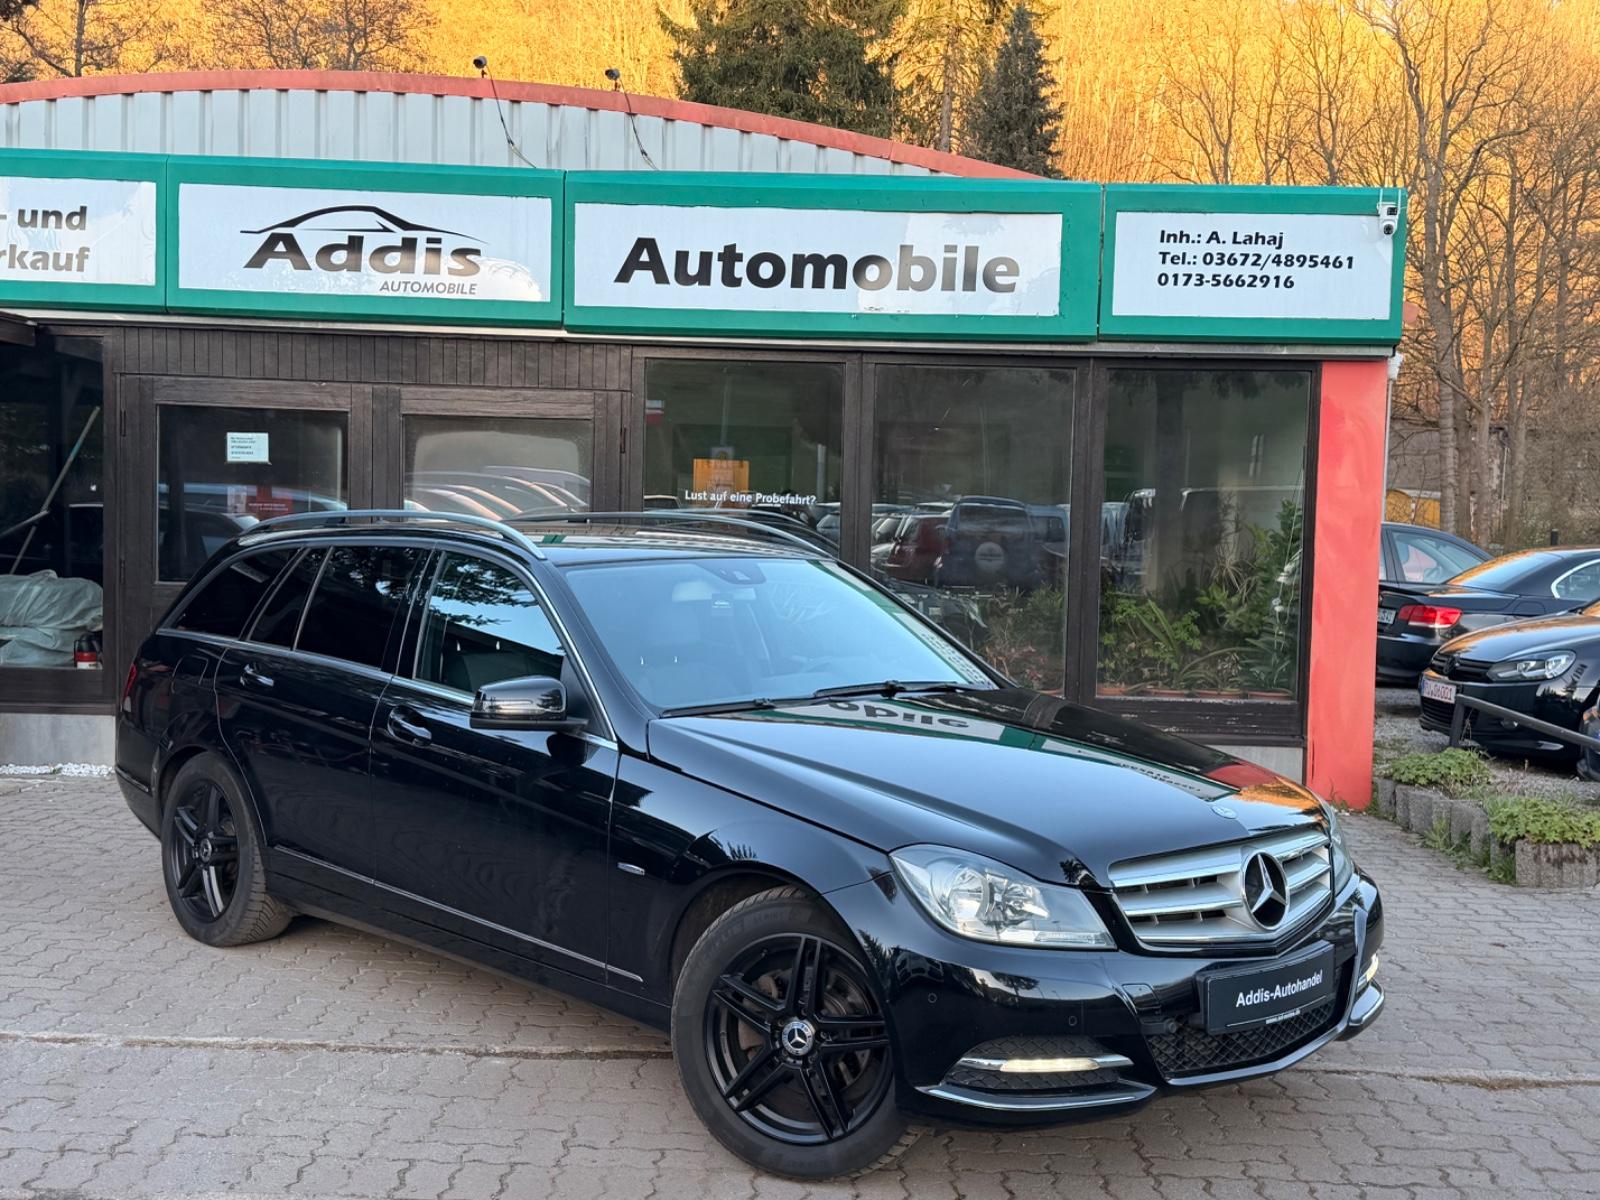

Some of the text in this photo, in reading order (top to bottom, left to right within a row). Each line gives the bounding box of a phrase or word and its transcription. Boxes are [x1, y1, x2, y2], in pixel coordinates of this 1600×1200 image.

[17, 205, 88, 231] und
[1159, 229, 1284, 250] Inh.: A. Lahaj
[243, 232, 482, 277] Addis
[1158, 251, 1353, 270] Tel.: 03672/4895461
[614, 237, 1020, 294] Automobile
[379, 280, 478, 296] AUTOMOBILE
[1157, 272, 1295, 289] 0173-5662916
[684, 489, 817, 506] Lust auf eine Probefahrt?
[1235, 968, 1323, 1008] Addis-Autohandel
